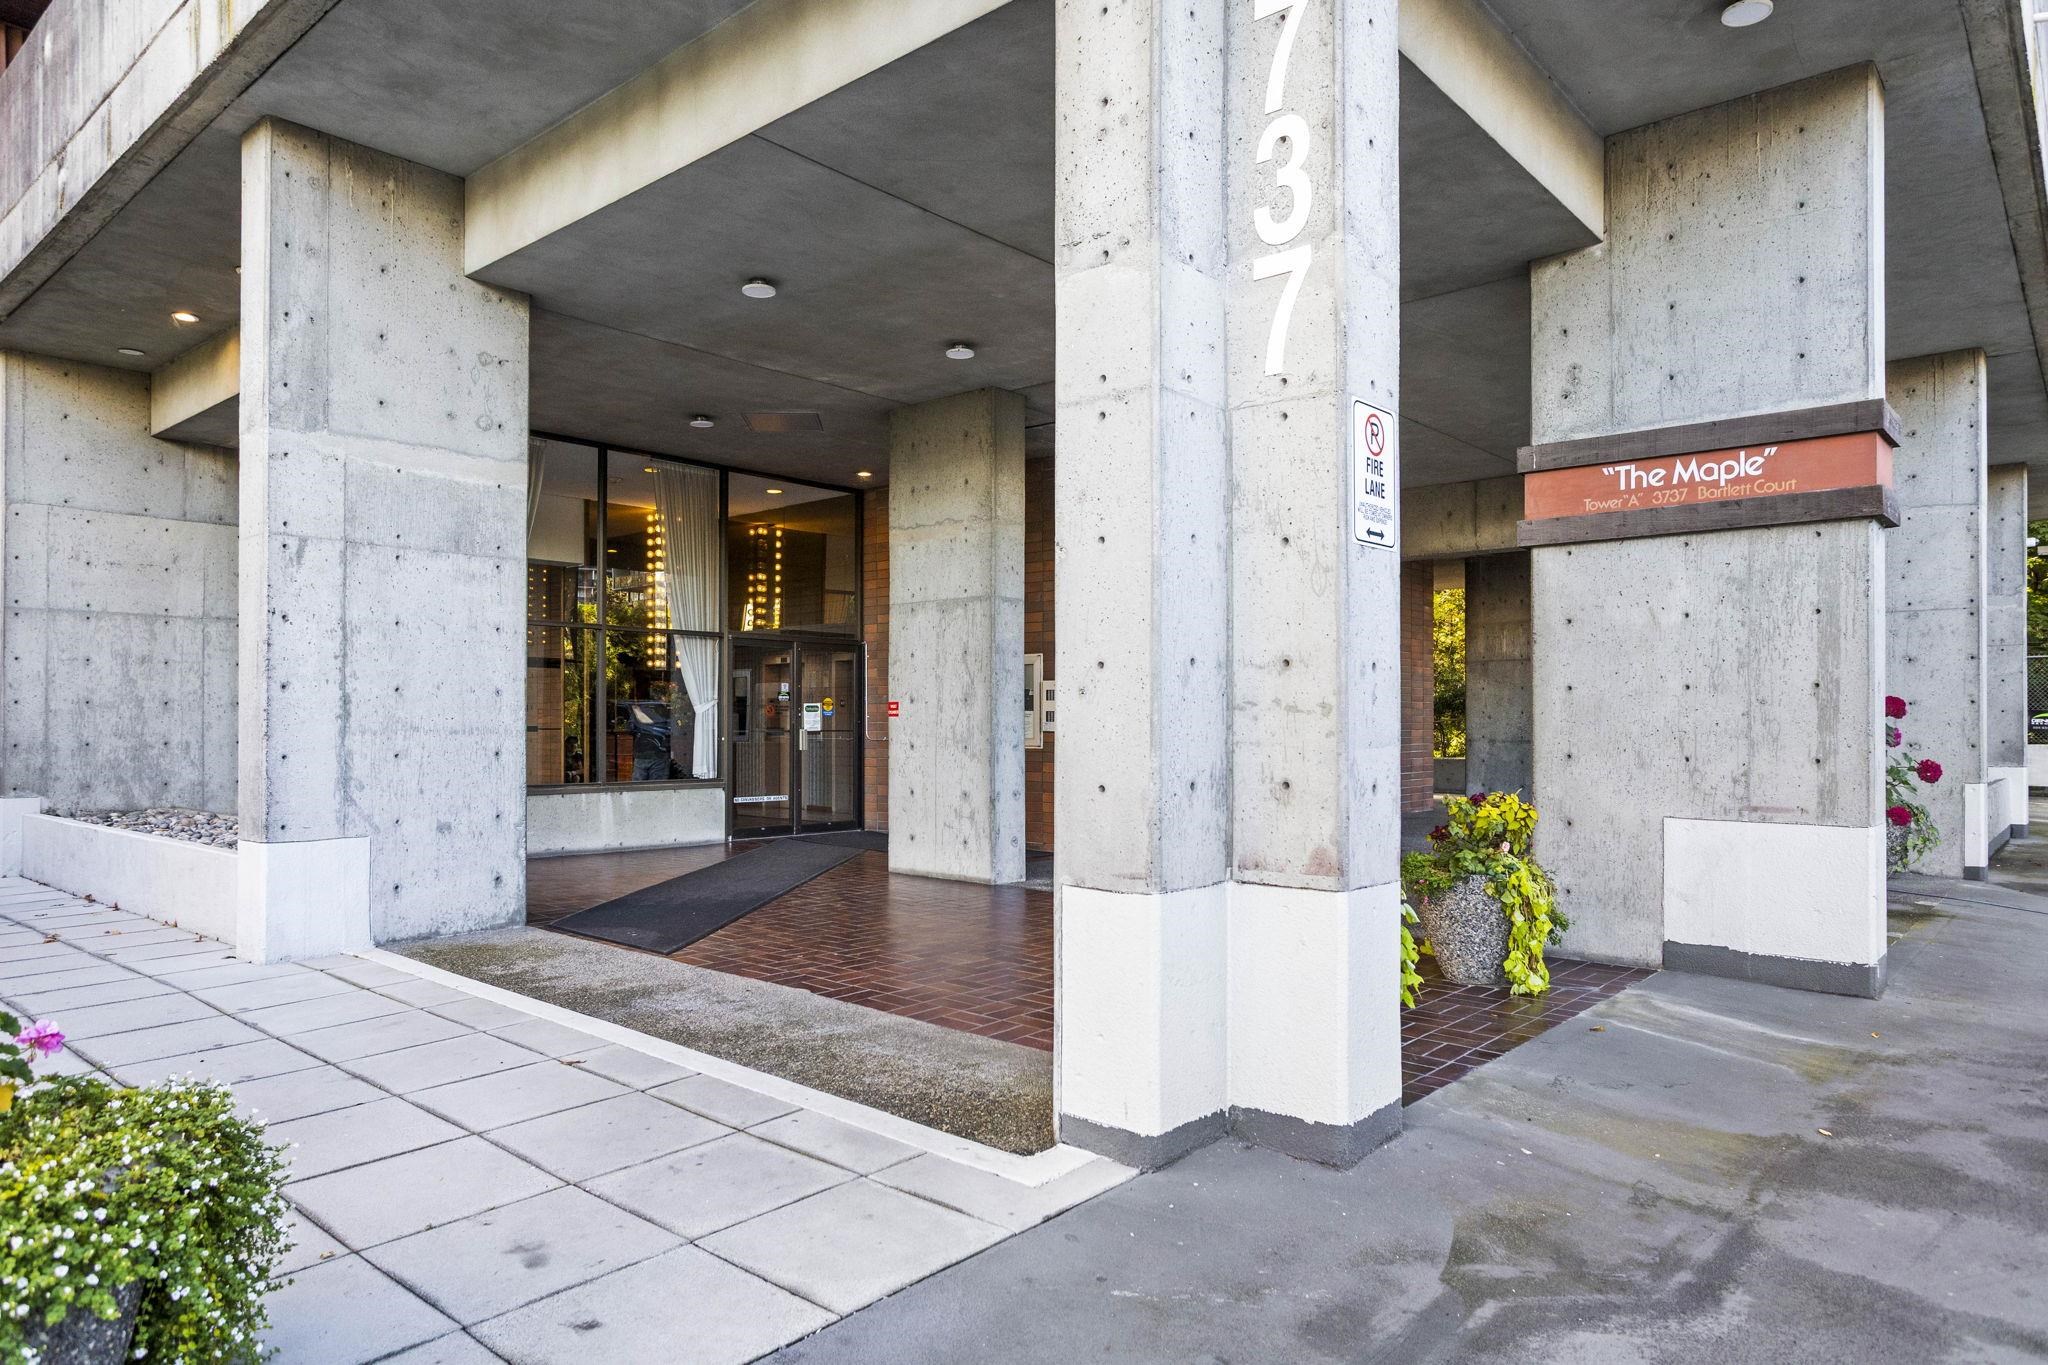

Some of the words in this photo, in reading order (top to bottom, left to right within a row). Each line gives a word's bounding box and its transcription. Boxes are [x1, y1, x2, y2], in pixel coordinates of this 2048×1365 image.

[1366, 457, 1384, 477] FIRE
[1602, 464, 1667, 491] "The
[1672, 446, 1777, 487] Maple"
[1365, 478, 1385, 499] LANE
[1652, 487, 1689, 505] 3737
[1698, 482, 1752, 500] Bartlett
[1754, 479, 1798, 494] Court
